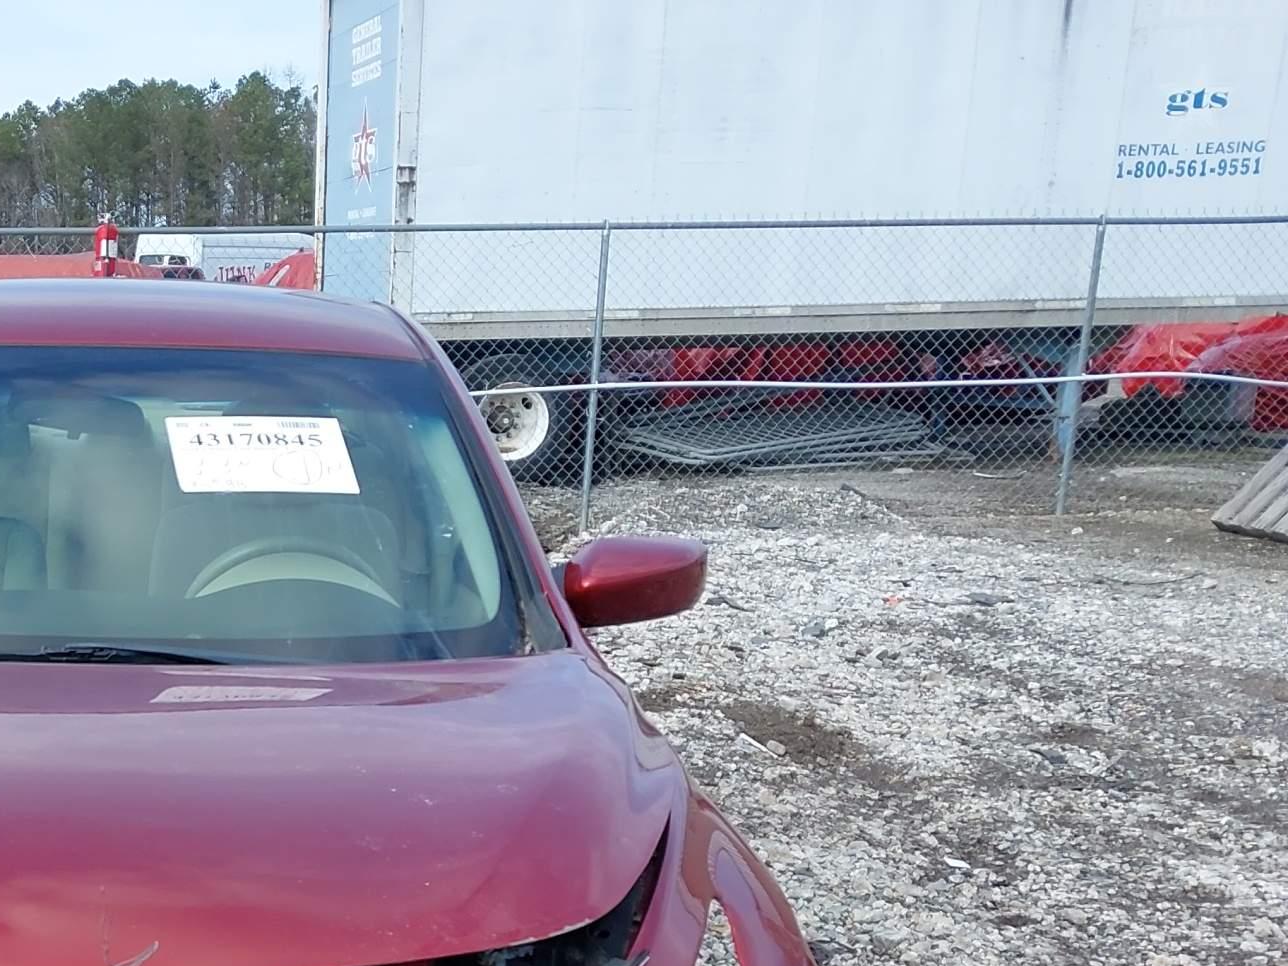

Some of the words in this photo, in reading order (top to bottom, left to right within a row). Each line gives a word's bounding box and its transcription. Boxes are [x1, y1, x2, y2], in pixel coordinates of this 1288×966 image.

[352, 36, 382, 65] TRAILER
[1166, 88, 1229, 116] gts
[1118, 143, 1180, 157] RENTAL
[1196, 140, 1266, 155] LEASING
[1116, 157, 1262, 179] 1-800-561-9551
[189, 433, 324, 448] 43170845
